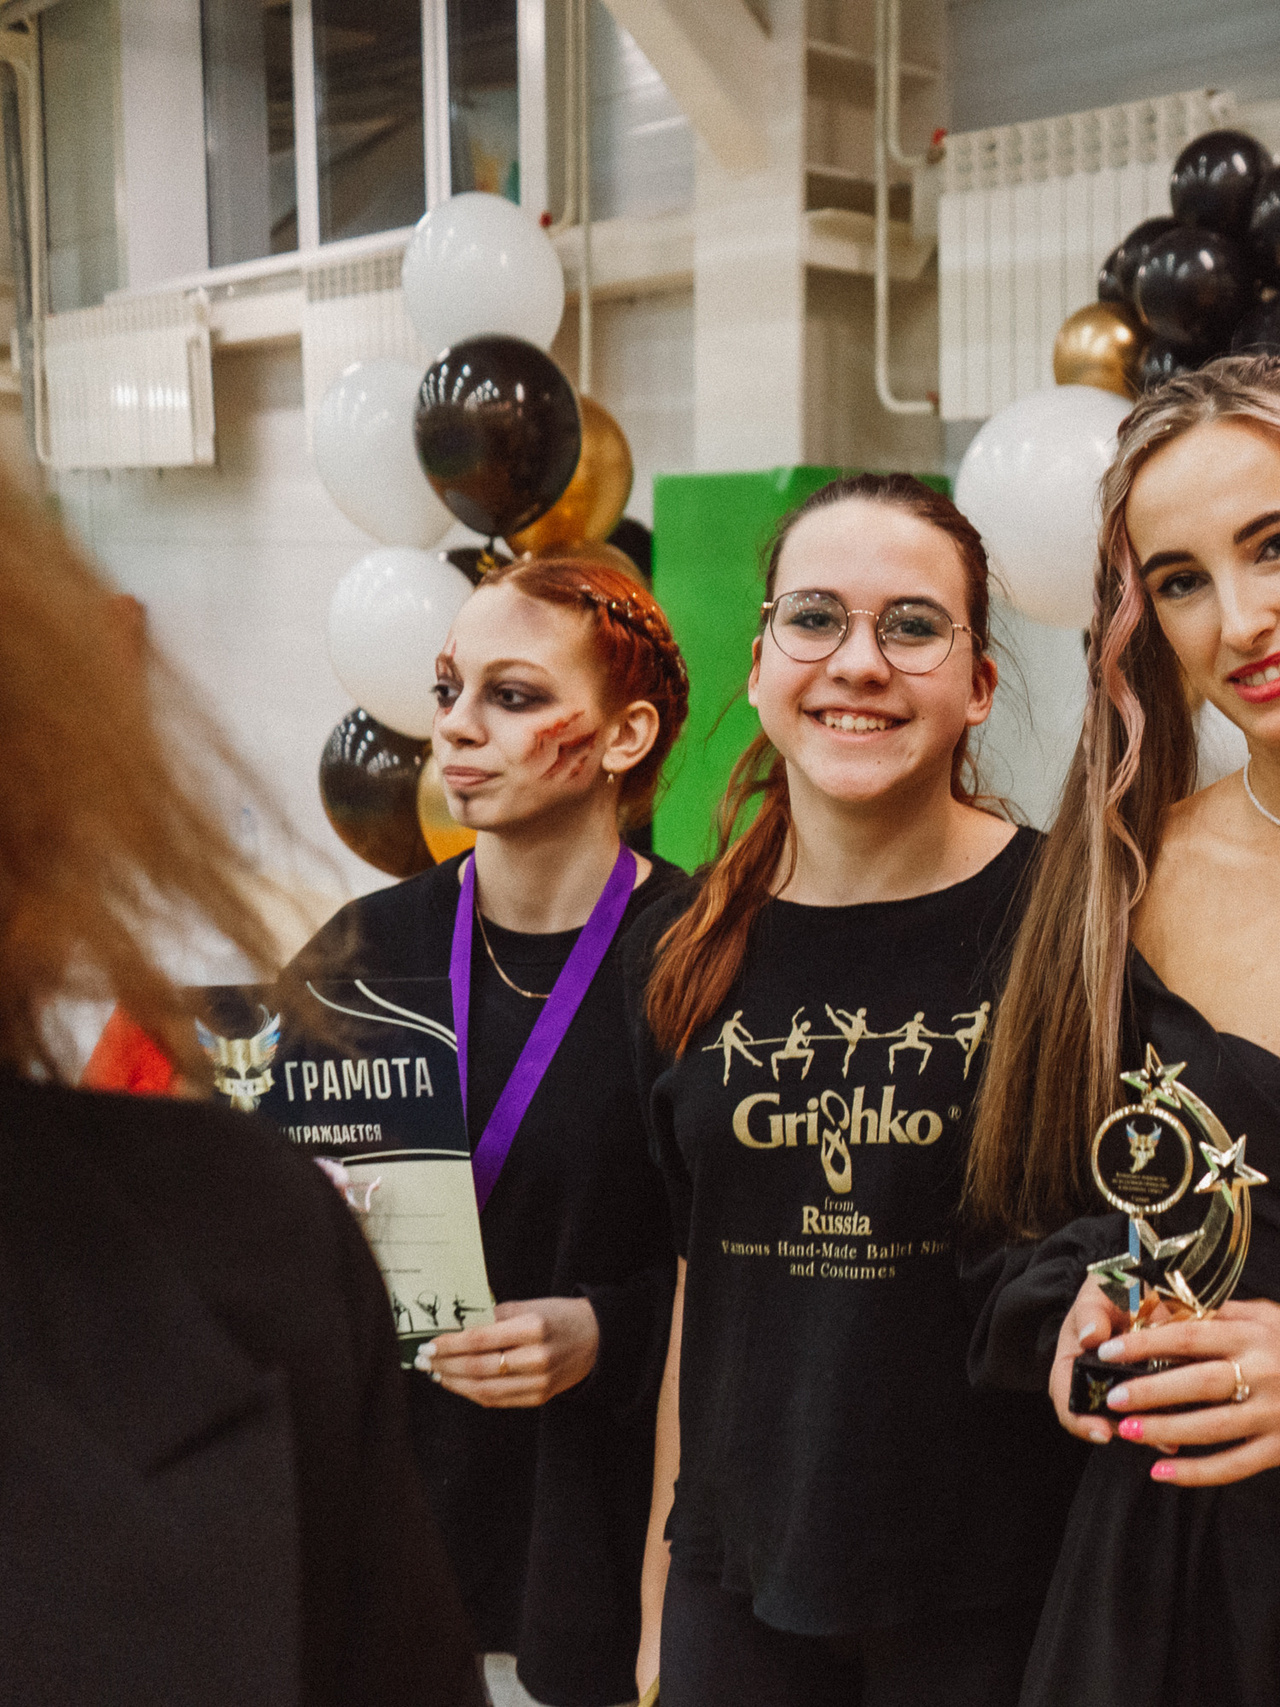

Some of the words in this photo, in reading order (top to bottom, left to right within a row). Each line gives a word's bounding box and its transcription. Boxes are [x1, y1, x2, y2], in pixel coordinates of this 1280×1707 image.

[284, 1057, 434, 1102] ГРАМОТА
[279, 1123, 383, 1145] АГРАЖДАЕТСЯ
[824, 1196, 854, 1212] from
[802, 1206, 873, 1236] Russia
[778, 1240, 858, 1260] Hand-Made
[867, 1241, 912, 1260] Ballet
[790, 1261, 815, 1277] and
[820, 1262, 896, 1280] Costumes
